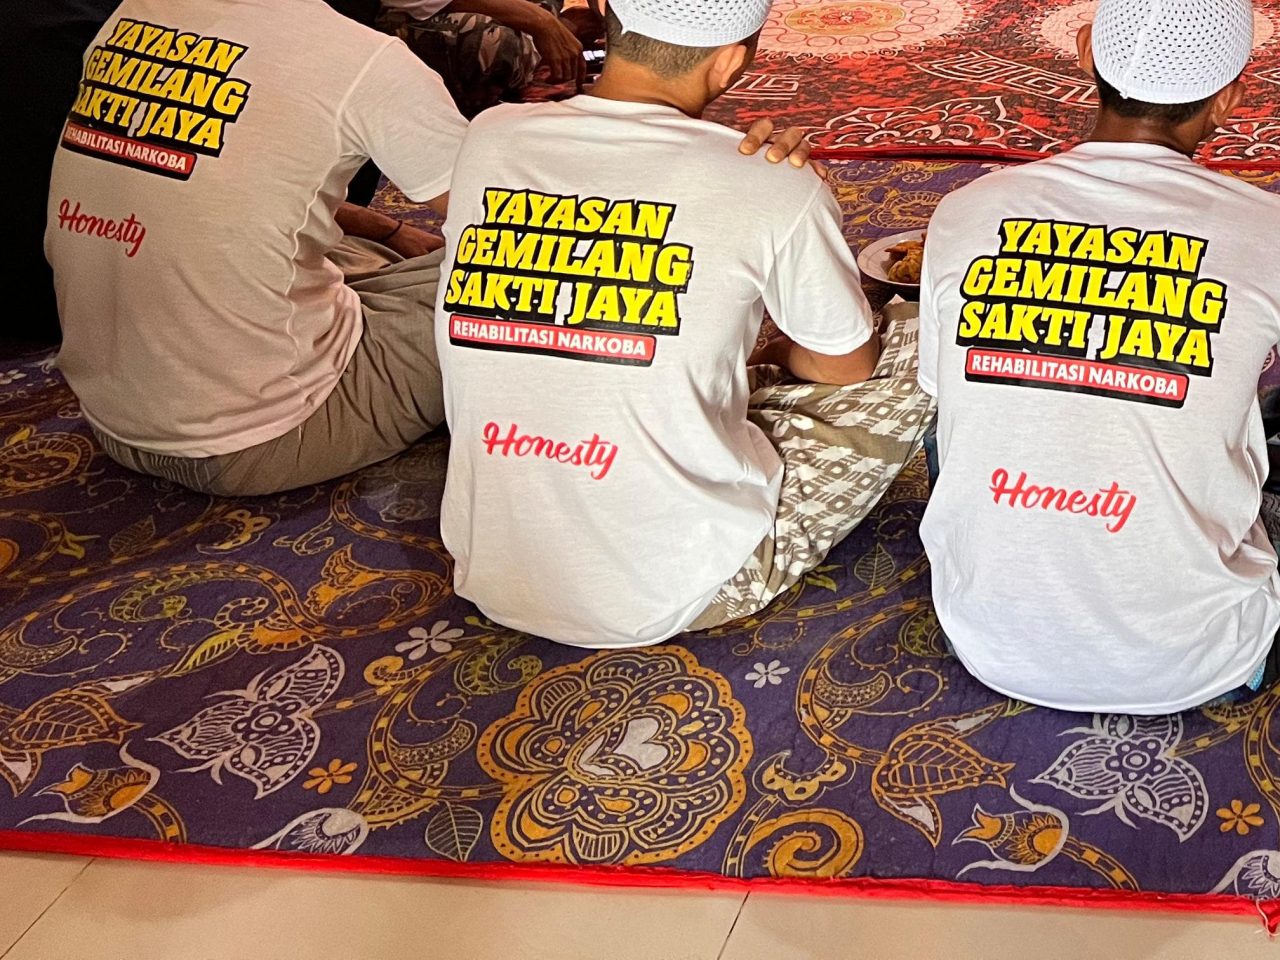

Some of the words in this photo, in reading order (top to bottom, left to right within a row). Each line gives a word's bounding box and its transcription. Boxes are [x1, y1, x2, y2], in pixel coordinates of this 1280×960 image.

[106, 20, 245, 73] YAYASAN
[85, 48, 248, 116] GEMILANG
[137, 102, 224, 150] JAYA
[125, 145, 187, 170] NARKOBA
[57, 198, 146, 258] Honesty
[484, 189, 673, 240] YAYASAN
[457, 227, 692, 286] GEMILANG
[1001, 220, 1203, 273] YAYASAN
[446, 269, 559, 315] SAKTI
[567, 281, 678, 328] JAYA
[963, 258, 1225, 325] GEMILANG
[453, 319, 555, 346] REHABILITASI
[557, 331, 647, 356] NARKOBA
[959, 301, 1093, 349] SAKTI
[1100, 315, 1211, 367] JAYA
[971, 354, 1085, 382] REHABILITASI
[1088, 367, 1178, 397] NARKOBA
[481, 421, 619, 481] Honesty
[989, 467, 1137, 533] Honesty
